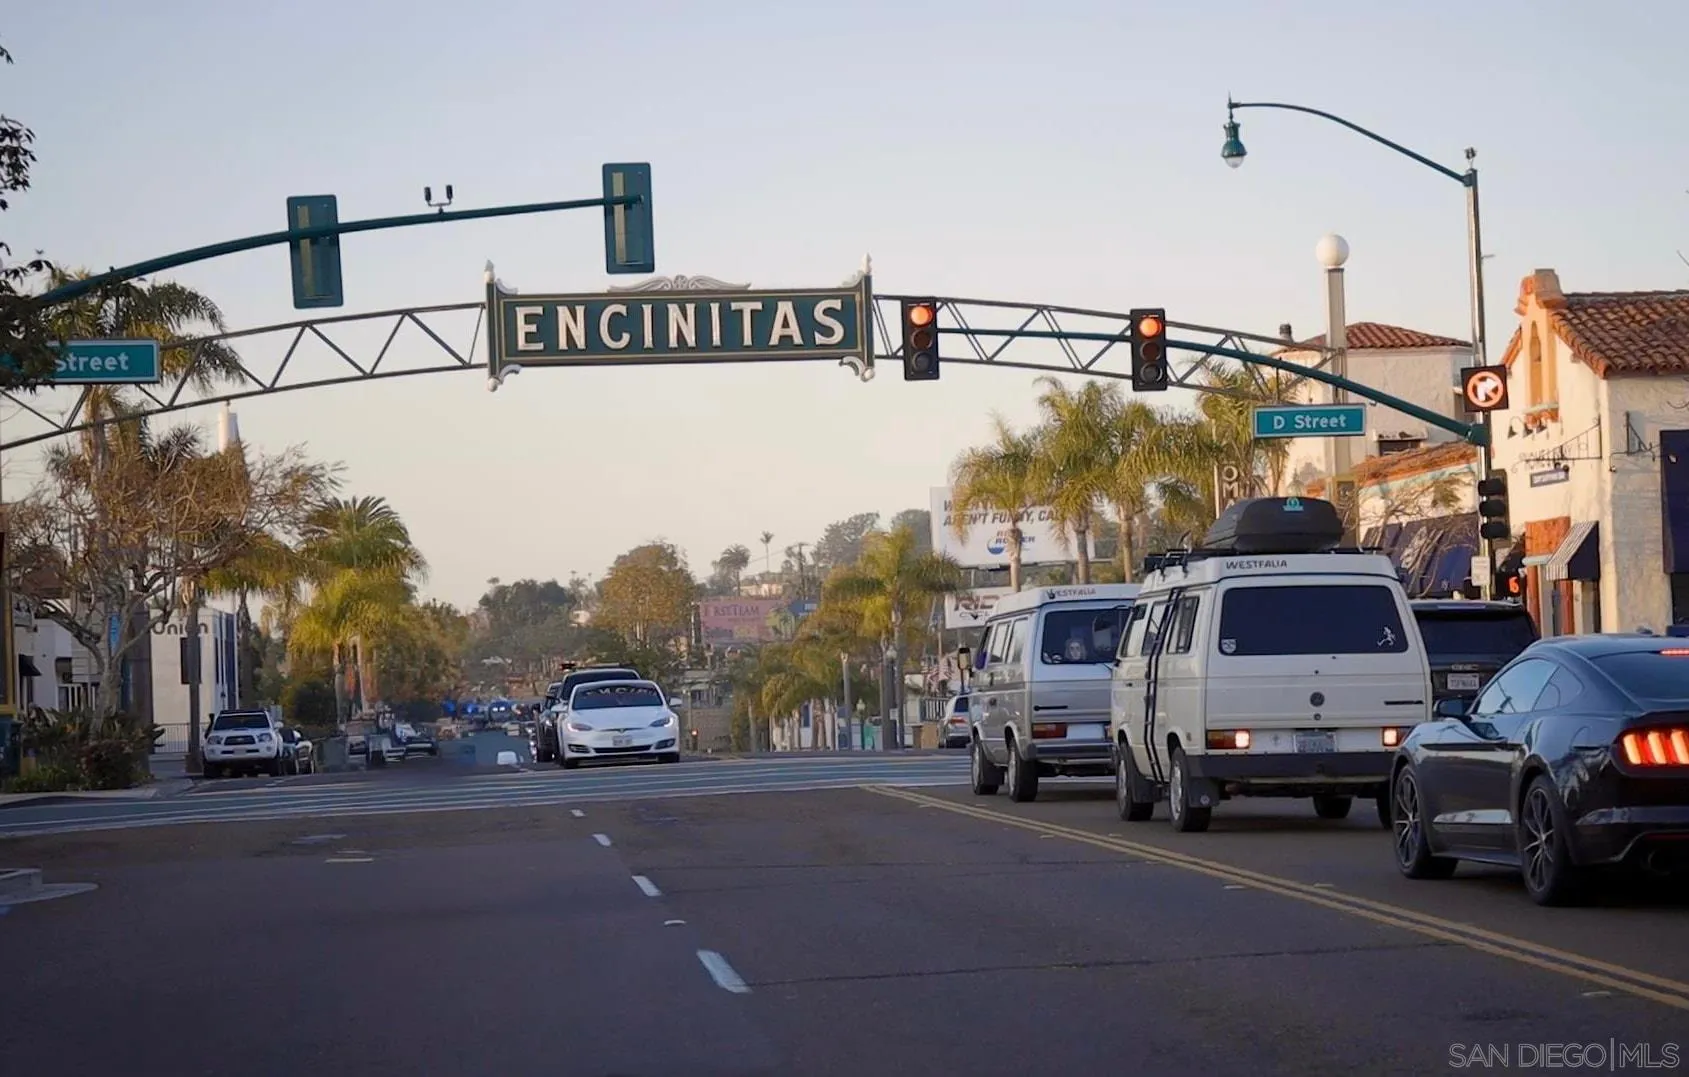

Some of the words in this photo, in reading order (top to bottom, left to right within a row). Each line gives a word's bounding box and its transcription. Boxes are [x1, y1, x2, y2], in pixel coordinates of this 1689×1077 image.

[515, 299, 845, 350] ENCINITAS
[1273, 415, 1285, 430] D
[1294, 414, 1347, 429] Street
[944, 512, 989, 526] AEN'T
[1226, 559, 1288, 570] WESTFALIA
[1508, 576, 1519, 593] 6
[152, 621, 208, 635] Unin
